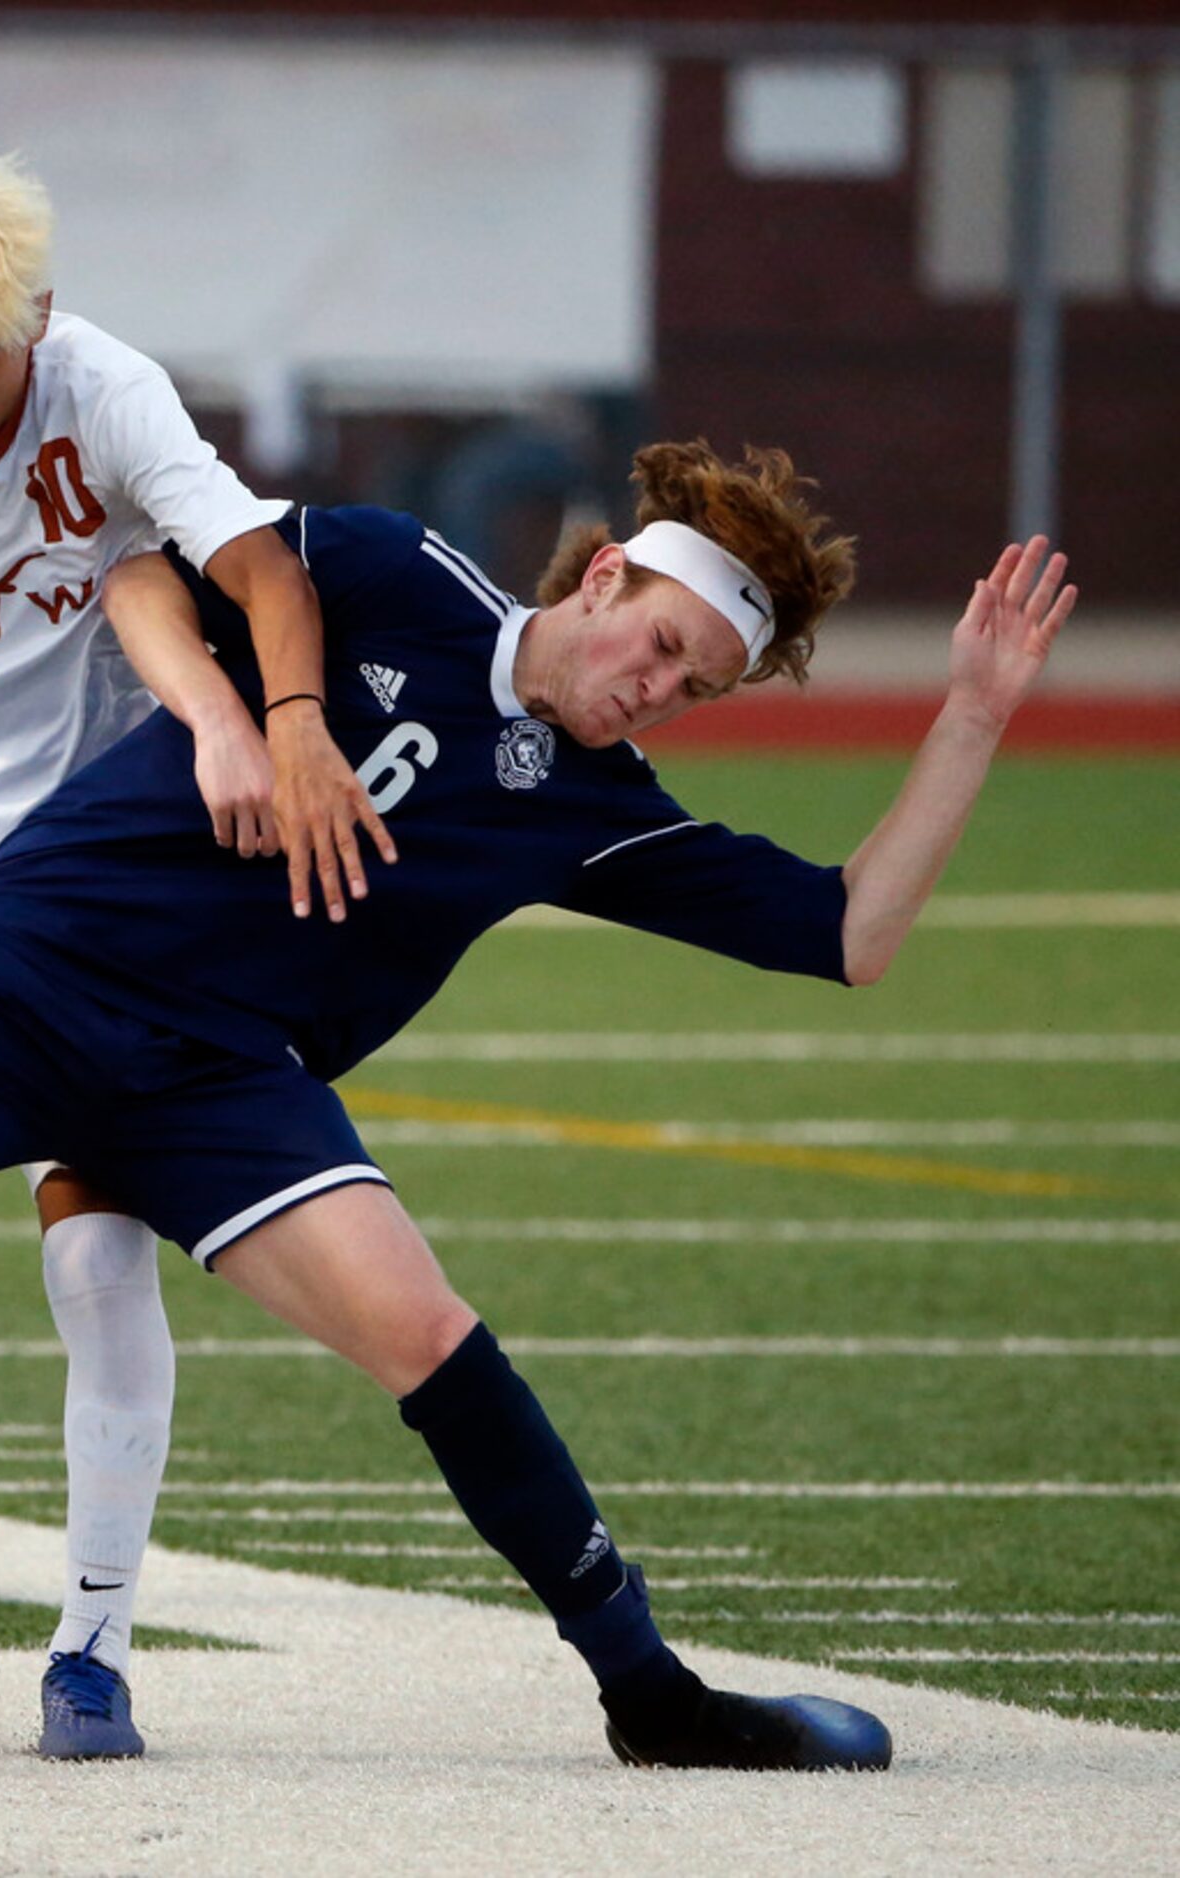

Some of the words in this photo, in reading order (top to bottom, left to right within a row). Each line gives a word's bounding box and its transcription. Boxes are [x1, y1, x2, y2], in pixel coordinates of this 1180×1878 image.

[25, 437, 107, 543] 10
[26, 577, 93, 624] W
[359, 663, 395, 713] adidas
[354, 721, 439, 815] 6
